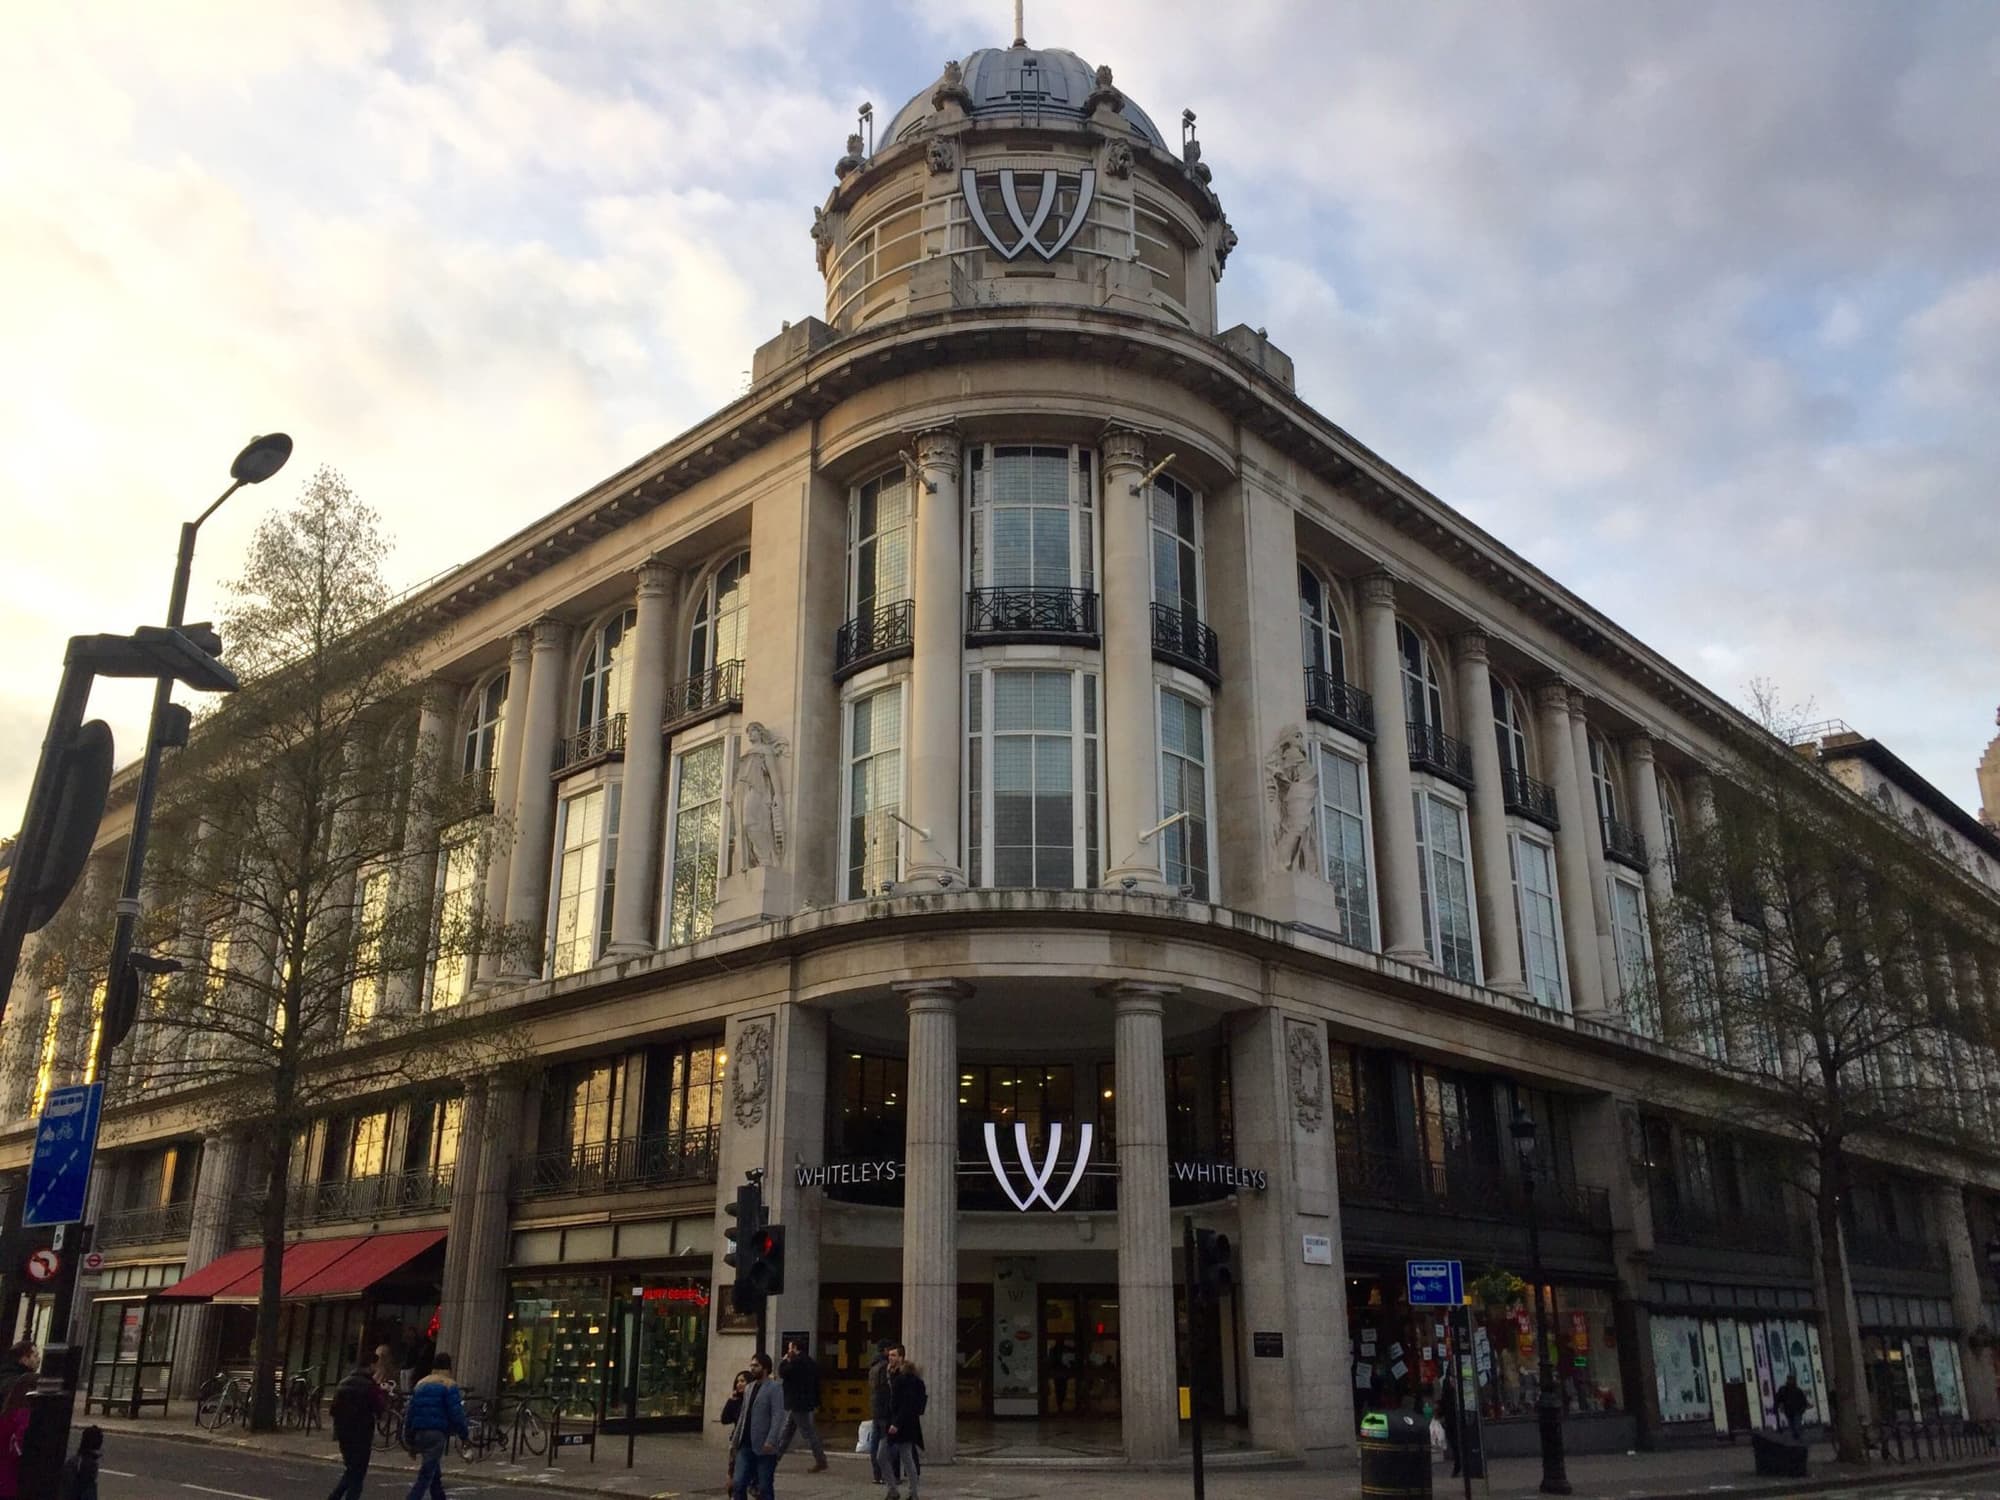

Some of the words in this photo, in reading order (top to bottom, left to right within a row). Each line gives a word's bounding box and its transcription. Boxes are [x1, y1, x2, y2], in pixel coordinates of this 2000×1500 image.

[961, 168, 1096, 263] W
[797, 1161, 896, 1187] WHITELEYS
[984, 1122, 1093, 1212] W
[1174, 1161, 1266, 1190] WHITELEYS
